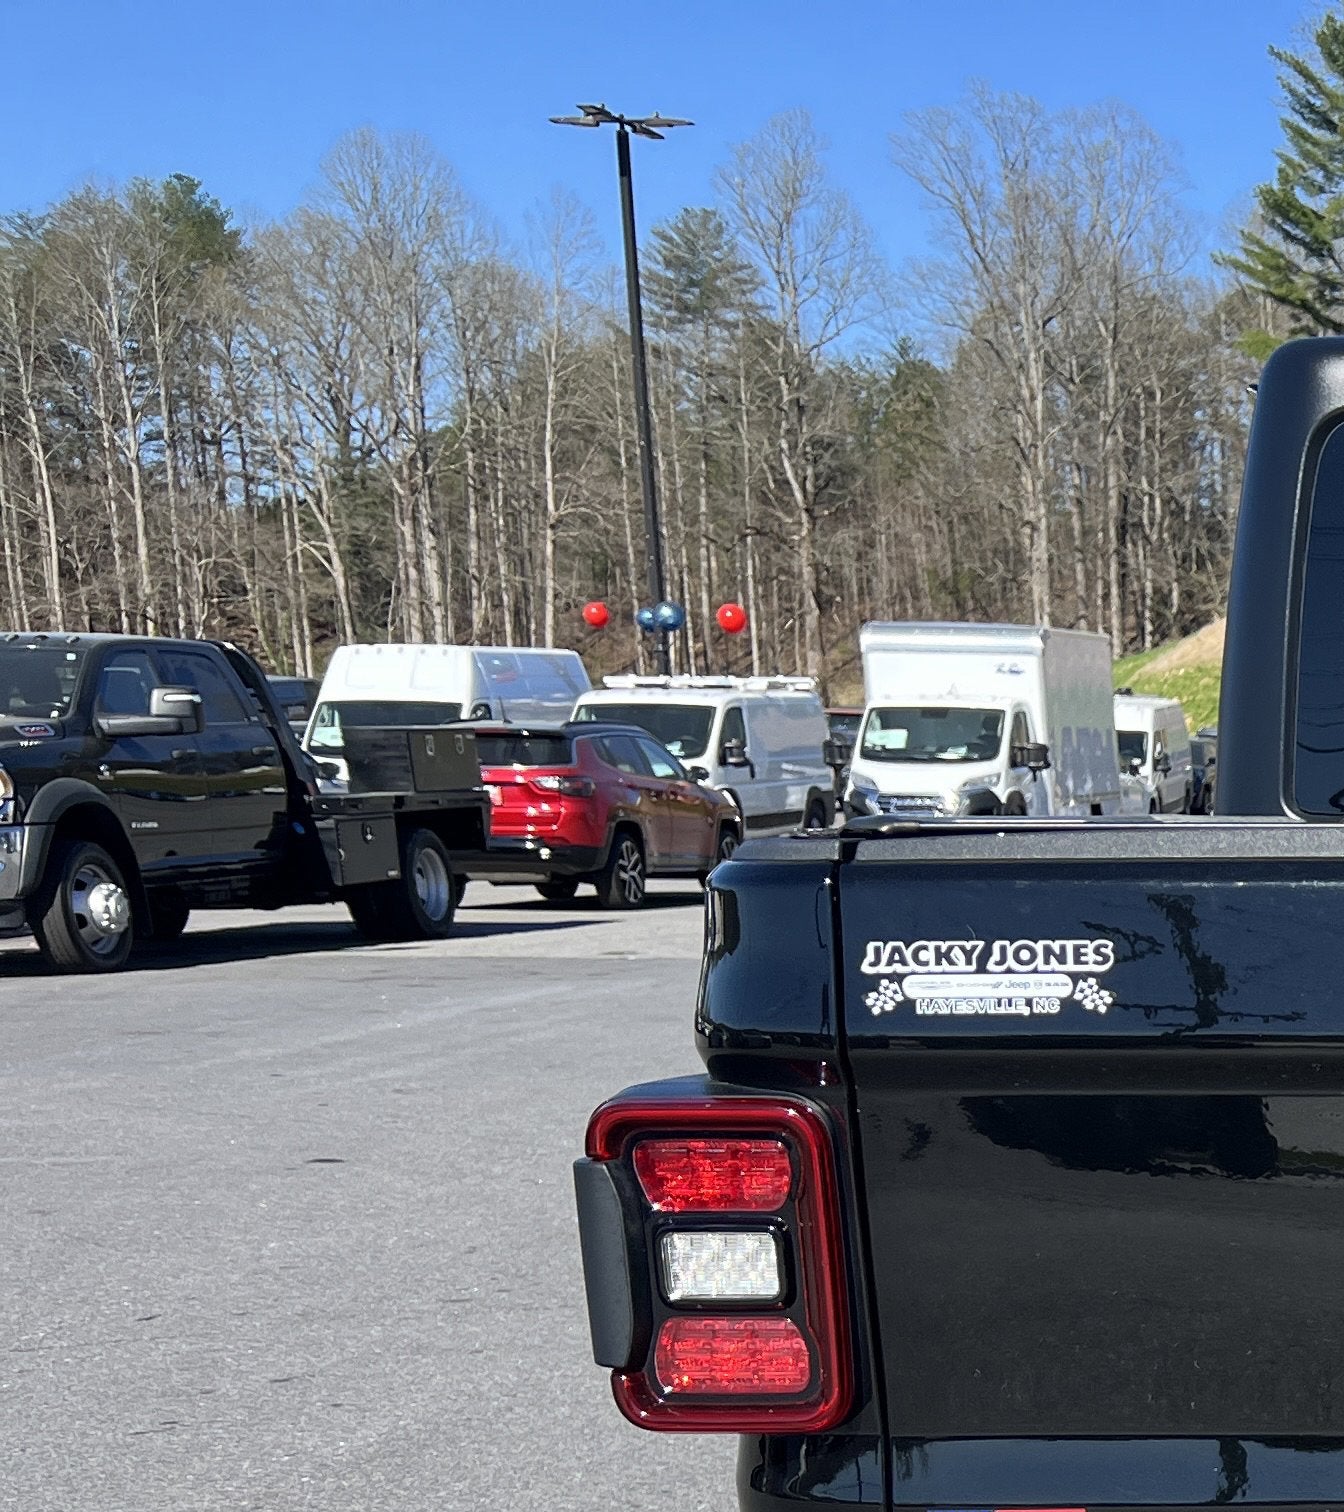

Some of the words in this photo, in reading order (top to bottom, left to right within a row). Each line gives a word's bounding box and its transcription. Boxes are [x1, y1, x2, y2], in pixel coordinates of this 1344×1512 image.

[861, 941, 984, 972] JACKY
[986, 940, 1113, 972] JONES
[1004, 979, 1031, 990] Jeep
[916, 998, 1031, 1015] HAYESVILLE,
[1032, 998, 1061, 1013] NC
